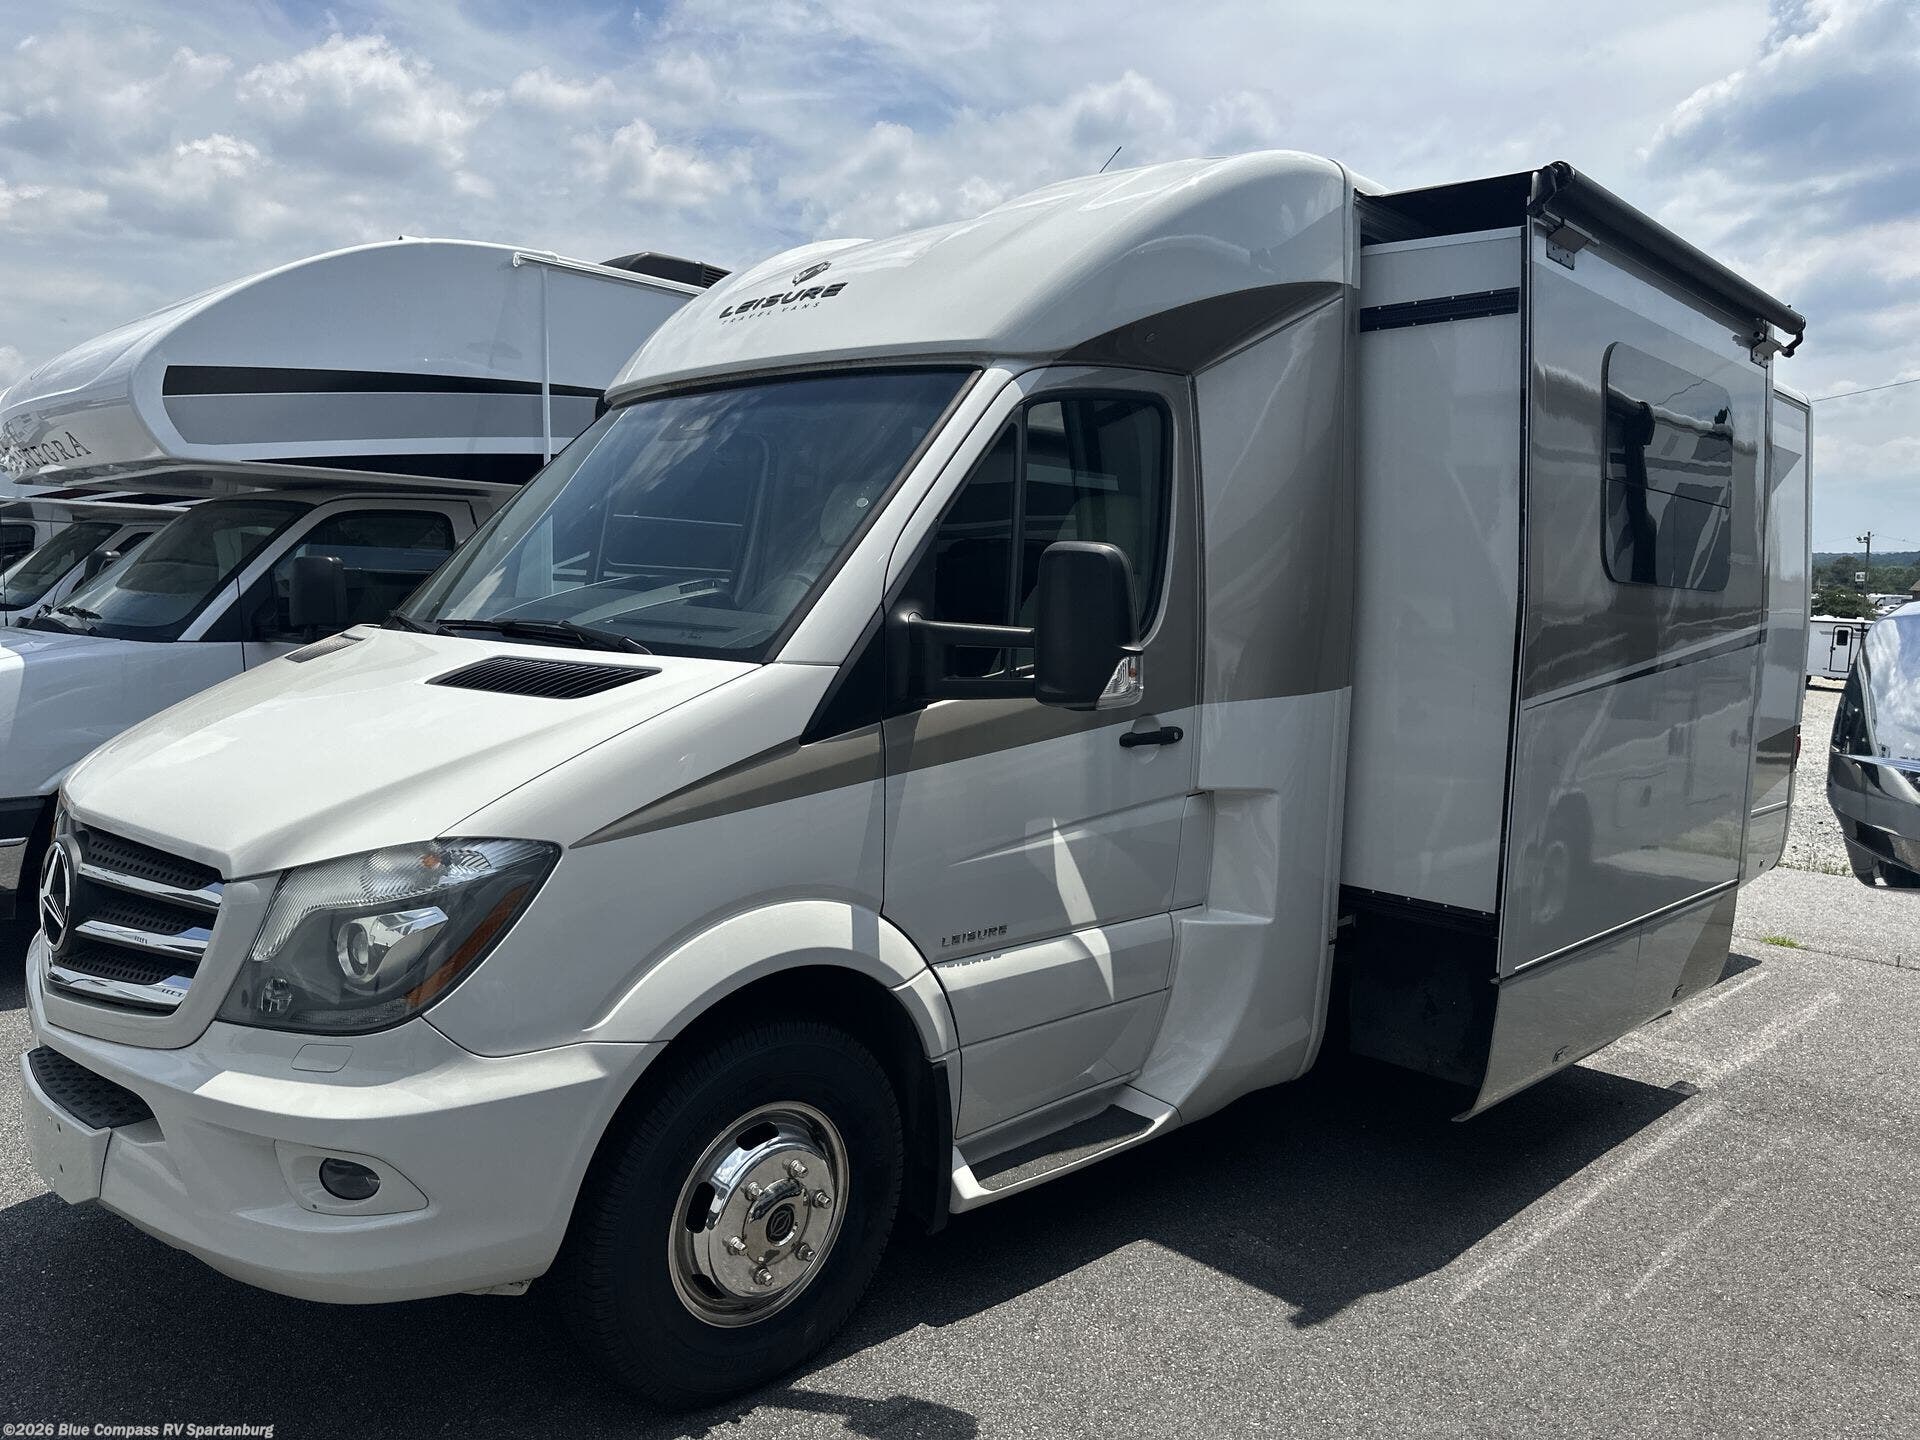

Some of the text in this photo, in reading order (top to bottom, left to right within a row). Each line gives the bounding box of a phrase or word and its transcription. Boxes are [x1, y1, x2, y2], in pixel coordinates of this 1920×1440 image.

[719, 282, 848, 319] LEISURE
[721, 301, 820, 325] TRAVEL VANS
[941, 924, 1008, 948] LEISURE
